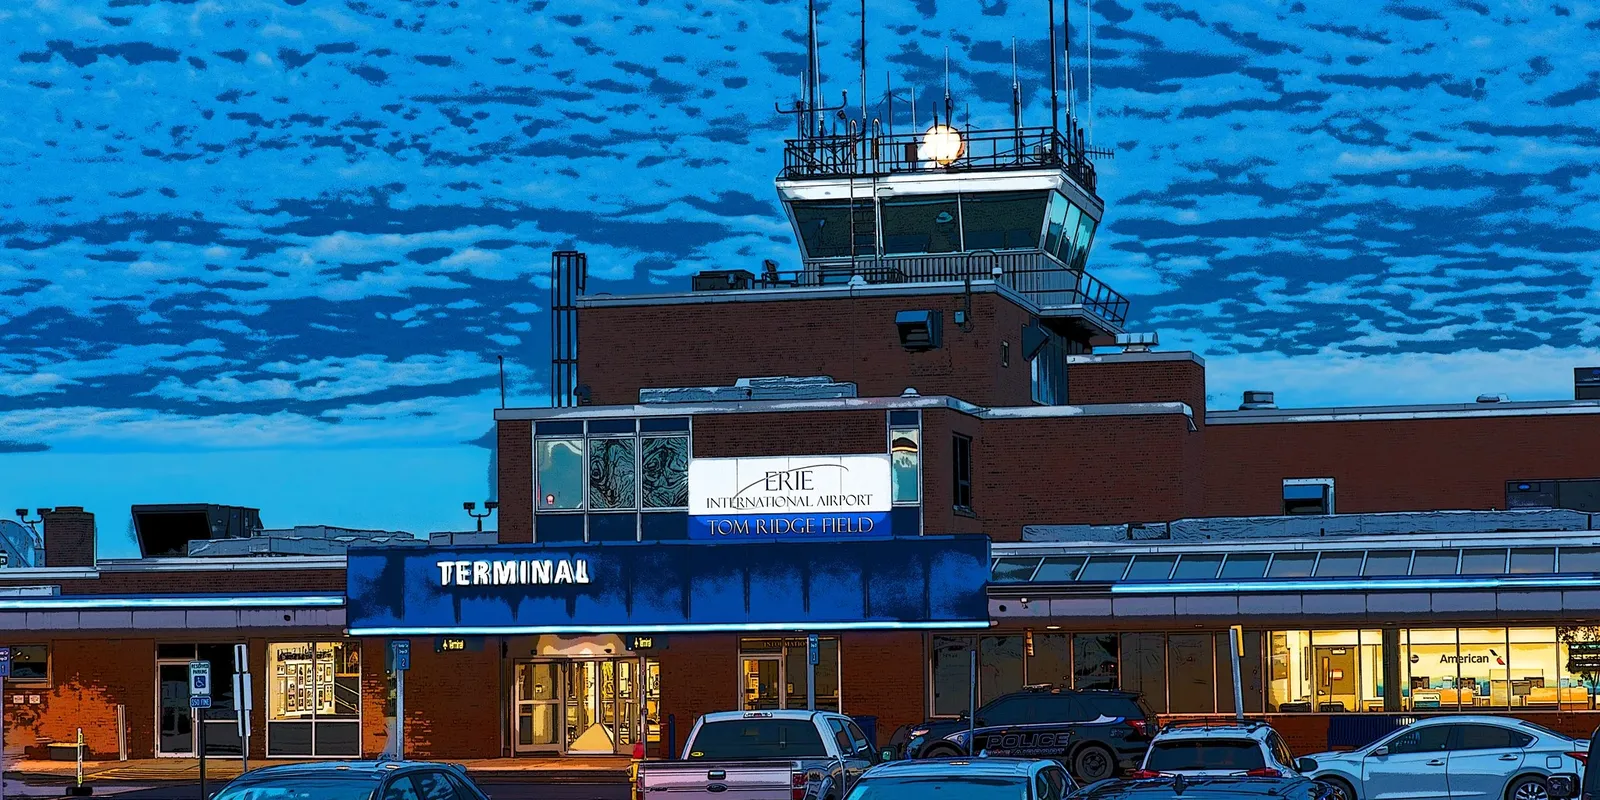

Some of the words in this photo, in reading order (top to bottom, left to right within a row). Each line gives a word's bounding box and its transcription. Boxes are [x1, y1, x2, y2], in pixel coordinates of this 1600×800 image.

[765, 470, 814, 492] ERIE
[706, 495, 813, 509] INTERNATIONAL
[817, 494, 873, 507] AIRPORT
[706, 518, 749, 536] TOM
[756, 517, 816, 535] RIDGE
[822, 516, 874, 533] FIELD
[436, 559, 590, 586] TERMINAL
[1440, 654, 1489, 664] American
[986, 732, 1070, 749] POLICE
